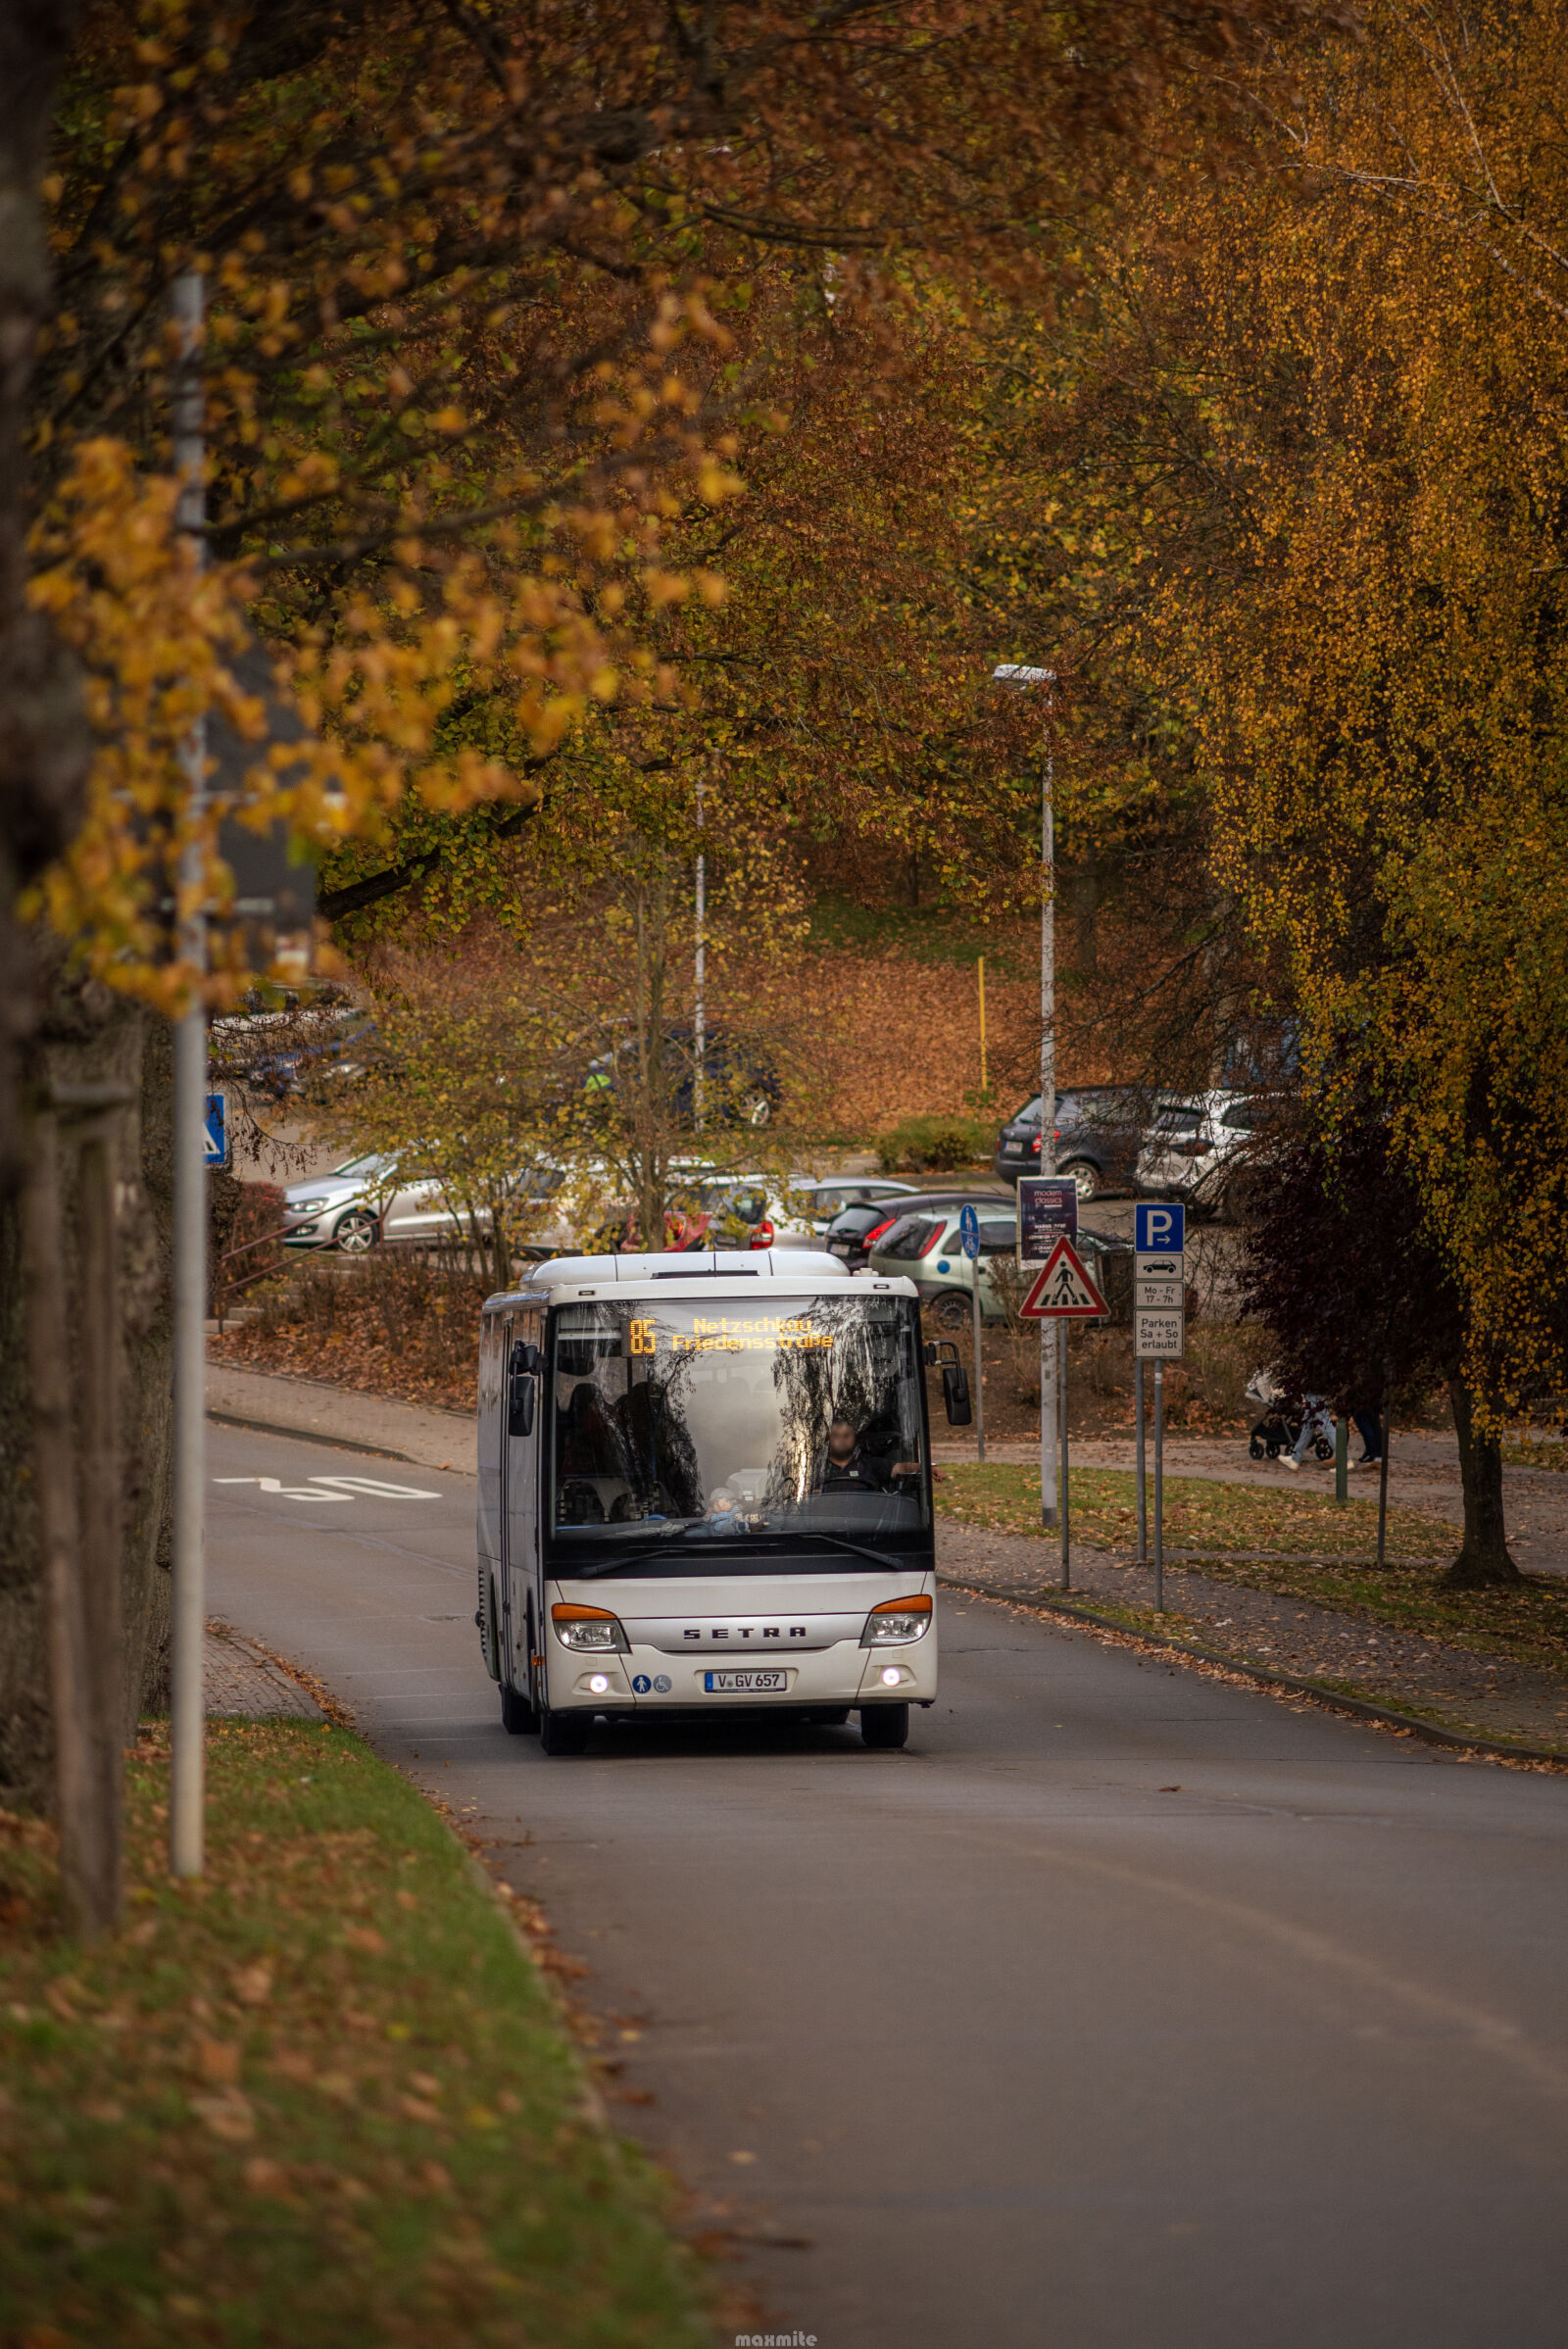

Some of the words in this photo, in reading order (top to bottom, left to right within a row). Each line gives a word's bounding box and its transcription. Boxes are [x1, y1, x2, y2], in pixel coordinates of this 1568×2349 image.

[1147, 1209, 1173, 1247] P
[1144, 1286, 1157, 1295] Mo
[1165, 1286, 1175, 1295] Fr
[693, 1316, 812, 1334] Netzschkau
[1141, 1318, 1178, 1328] Parken
[630, 1319, 657, 1354] 85
[1140, 1329, 1153, 1339] Sa
[1165, 1329, 1178, 1339] So
[672, 1333, 834, 1350] Friedensstraße
[1141, 1340, 1178, 1349] erlaubt
[683, 1627, 807, 1639] SETRA
[718, 1675, 727, 1688] V
[735, 1675, 753, 1688] GV
[755, 1674, 780, 1687] 657
